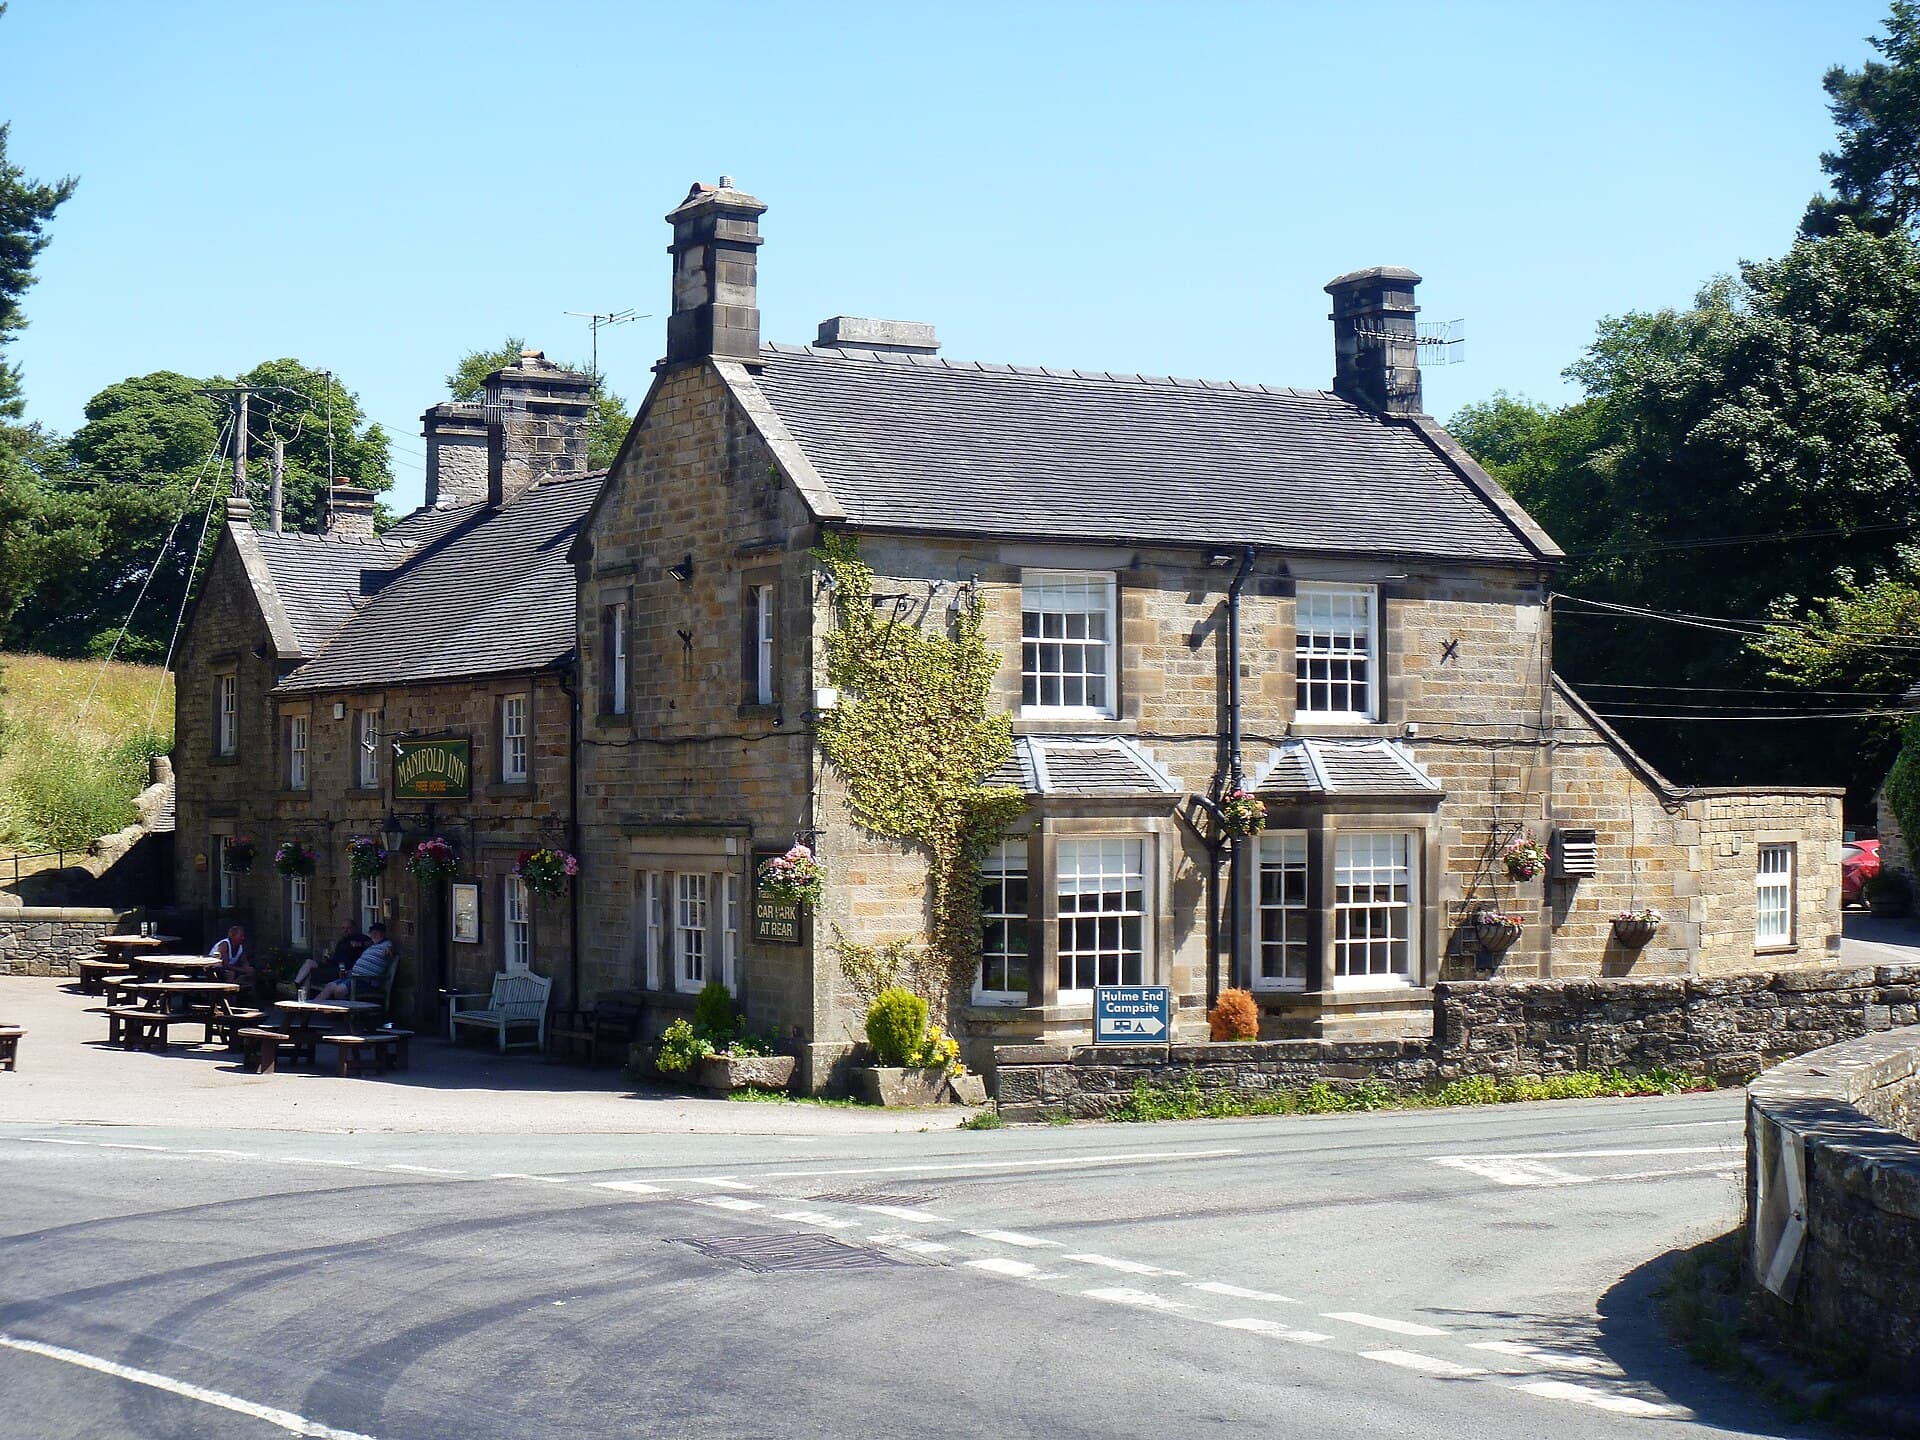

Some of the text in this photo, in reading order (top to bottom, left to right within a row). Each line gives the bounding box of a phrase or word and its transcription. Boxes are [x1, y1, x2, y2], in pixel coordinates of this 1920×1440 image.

[398, 747, 467, 788] MANIFOLD INN
[757, 904, 774, 919] CAR
[760, 921, 793, 937] AT REAR
[1101, 990, 1164, 1001] Hulme End
[1105, 1002, 1160, 1015] Campsite
